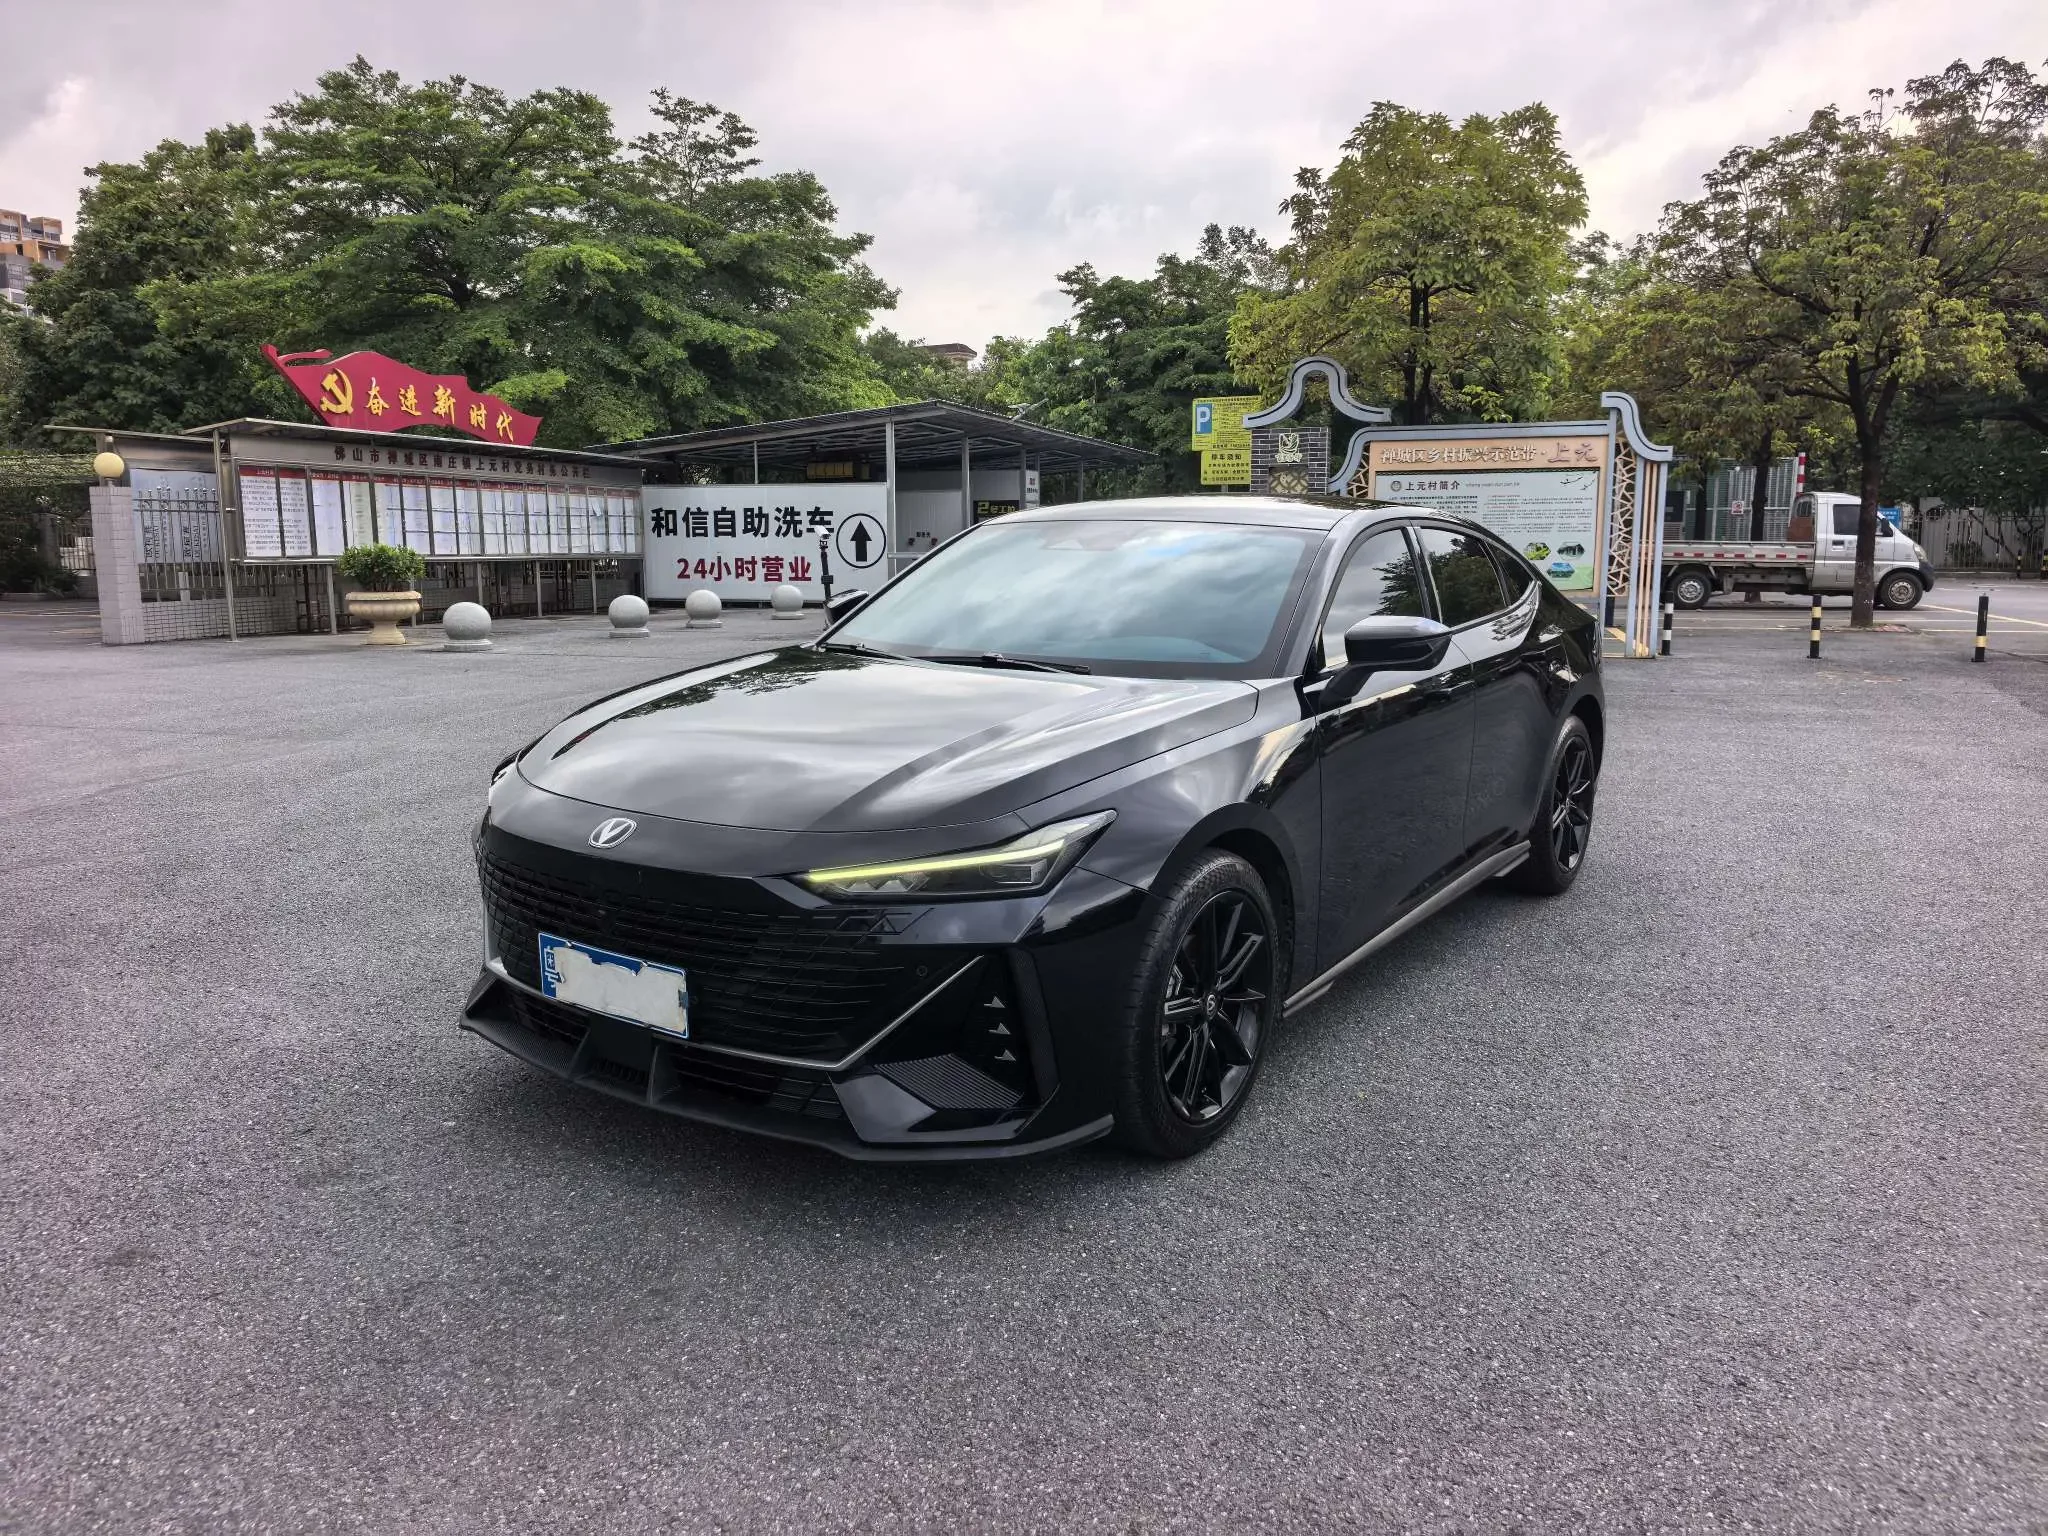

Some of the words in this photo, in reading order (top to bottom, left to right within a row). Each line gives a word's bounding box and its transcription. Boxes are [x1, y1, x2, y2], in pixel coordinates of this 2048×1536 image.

[365, 376, 514, 442] 奋进新时代
[1196, 406, 1211, 432] P
[1405, 480, 1461, 491] 上元村简介
[651, 505, 835, 538] 和信自助洗车
[676, 555, 812, 582] 24小时营业
